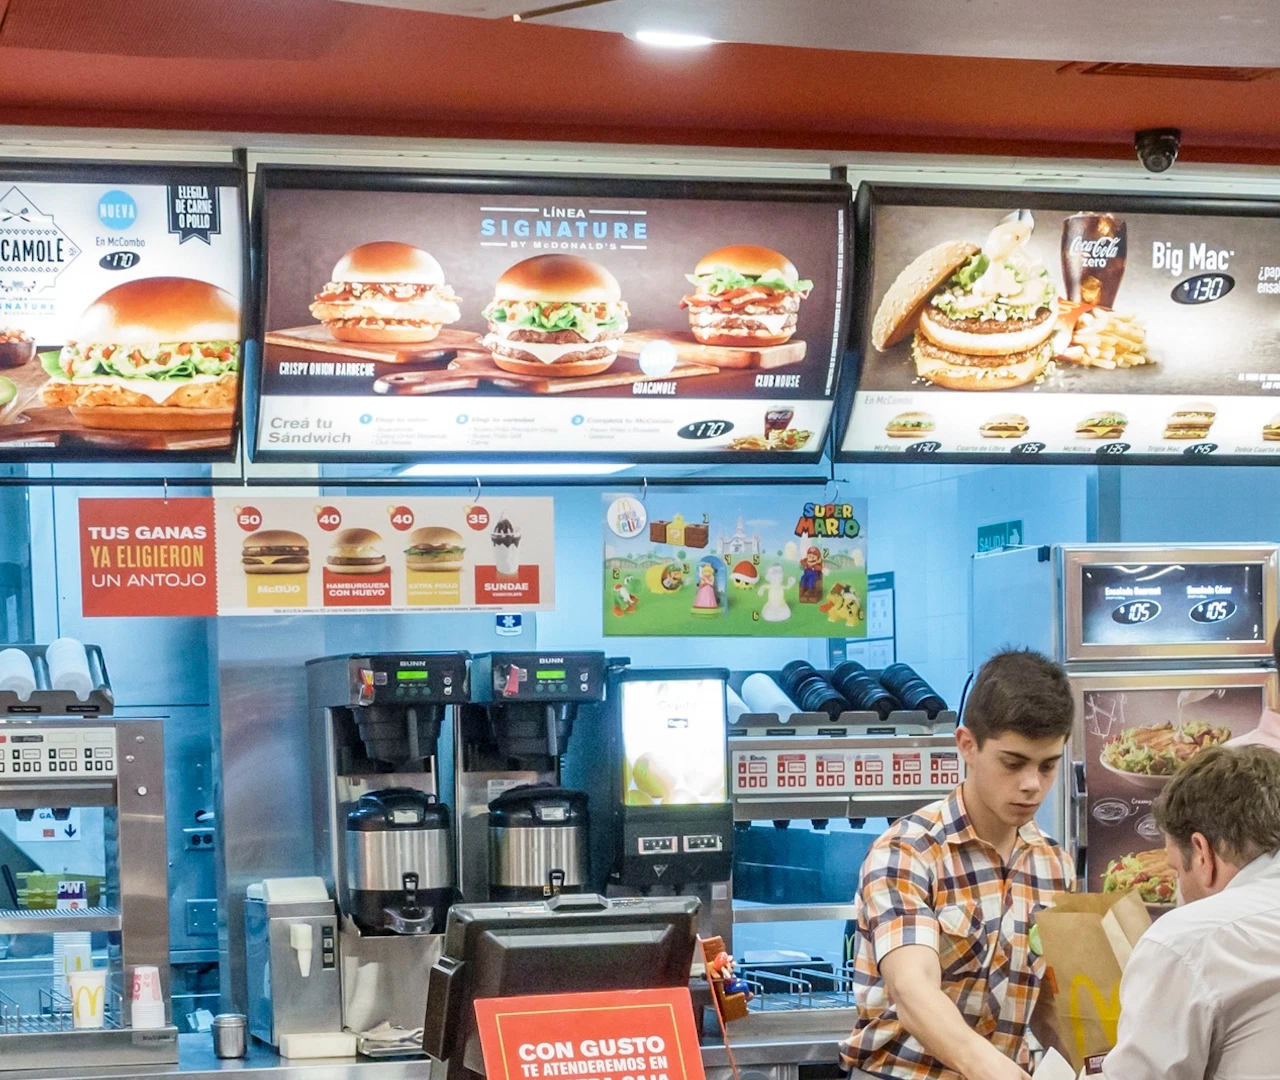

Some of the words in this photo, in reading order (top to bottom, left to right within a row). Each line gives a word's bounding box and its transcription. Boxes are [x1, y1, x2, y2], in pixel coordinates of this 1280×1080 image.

[100, 203, 136, 219] NUEVA
[175, 200, 186, 213] DE
[187, 200, 213, 214] CARNE
[544, 206, 586, 218] LÍNEA
[179, 214, 186, 227] O
[187, 214, 210, 229] POLLO
[481, 218, 647, 240] SIGNATURE
[95, 237, 106, 247] En
[108, 237, 146, 247] McCombo
[511, 241, 527, 249] BY
[534, 241, 617, 250] McDONALD'S
[1081, 257, 1107, 268] zero
[1152, 241, 1181, 276] Big
[1190, 242, 1229, 271] Mac
[279, 362, 308, 375] CRISPY
[309, 362, 335, 376] ONION
[335, 362, 375, 376] BARBECUE
[755, 374, 773, 387] CLUB
[775, 374, 800, 388] HOUSE
[633, 382, 676, 395] GUACAMOLE
[271, 416, 309, 429] Creá
[316, 417, 333, 429] tu
[268, 432, 351, 443] Sándwich
[803, 502, 853, 518] SUPER
[239, 515, 260, 525] 50
[320, 514, 340, 524] 40
[393, 514, 412, 524] 40
[468, 514, 488, 524] 35
[88, 526, 129, 540] TUS
[135, 526, 207, 540] GANAS
[794, 516, 860, 539] MARIO
[979, 535, 1006, 552] SALIDA
[90, 546, 111, 568] YA
[117, 545, 204, 568] ELIGIERON
[92, 573, 121, 588] UN
[127, 573, 207, 588] ANTOJO
[326, 582, 389, 590] HAMBURGUESA
[408, 582, 433, 590] EXTRA
[484, 582, 529, 592] SUNDAE
[329, 589, 350, 597] CON
[352, 589, 386, 597] HUEVO
[519, 1041, 574, 1061] CON
[580, 1035, 665, 1057] GUSTO
[521, 1064, 539, 1078] TE
[543, 1058, 646, 1076] ATENDEREMOS
[650, 1056, 668, 1069] EN
